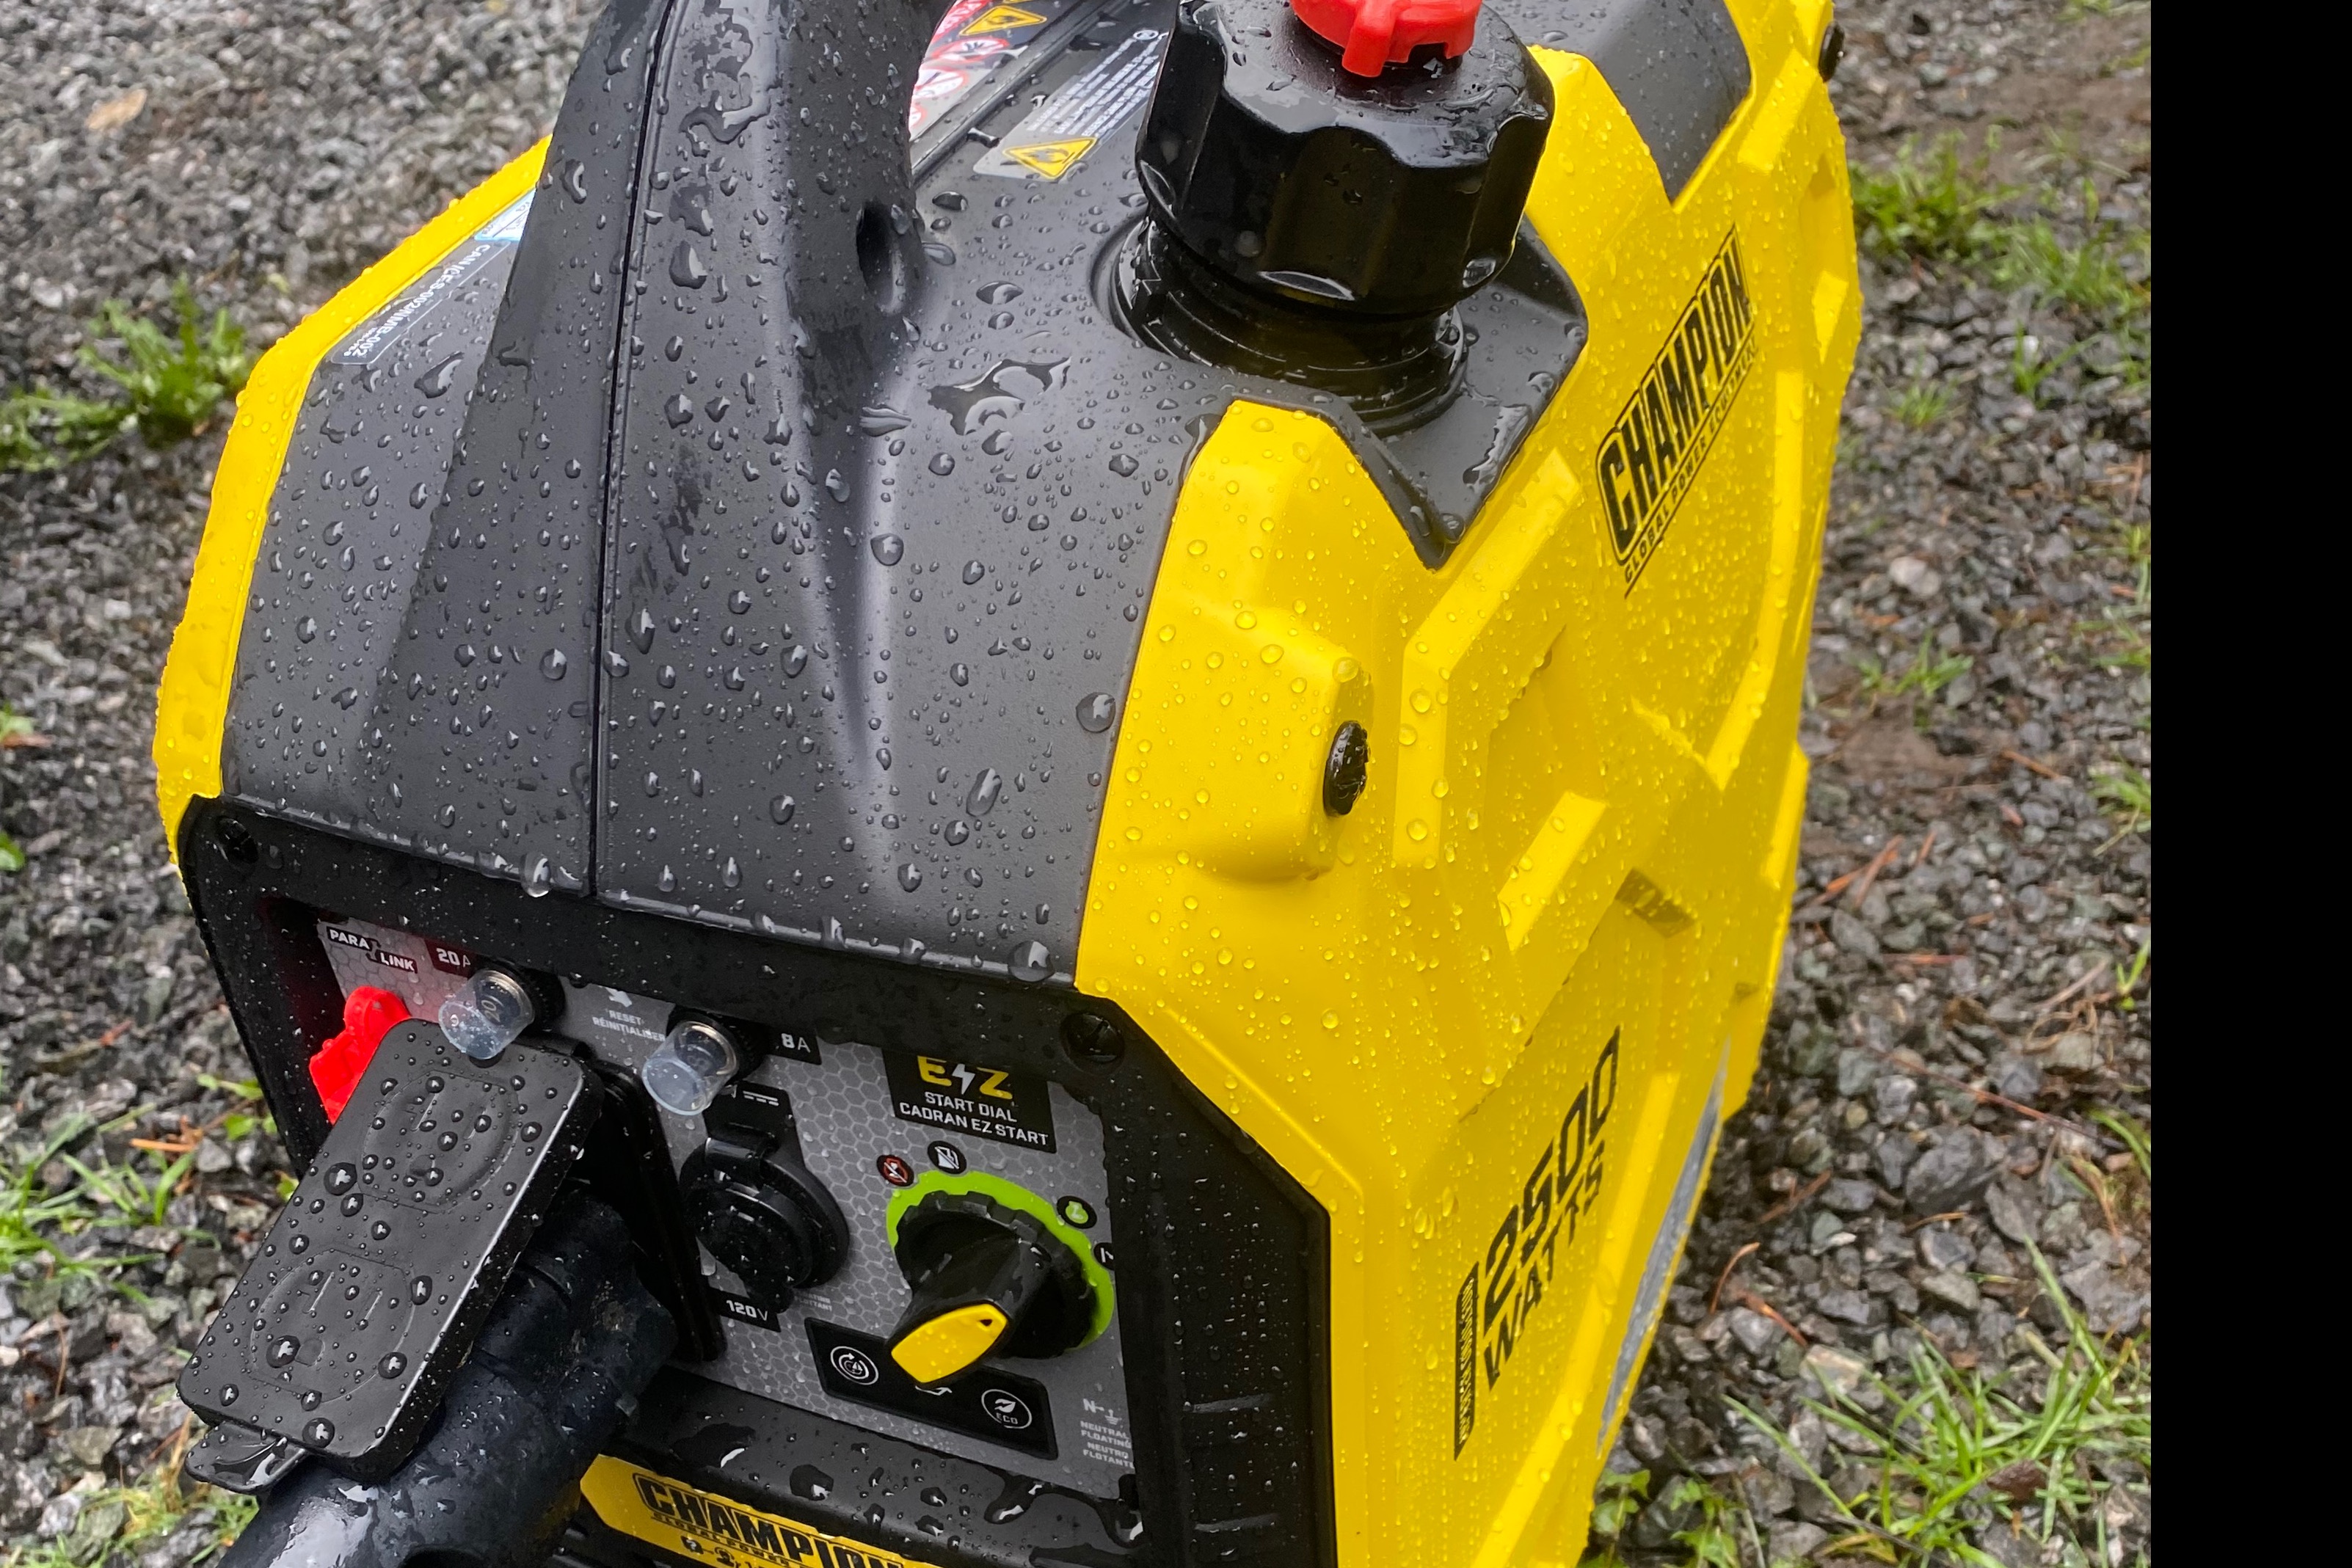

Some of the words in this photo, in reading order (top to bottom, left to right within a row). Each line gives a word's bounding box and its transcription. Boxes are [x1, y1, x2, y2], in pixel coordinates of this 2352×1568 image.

[457, 244, 491, 266] CAN
[1600, 236, 1752, 555] CHAMPION
[1624, 504, 1670, 583] GLOBAL
[1672, 435, 1706, 504] POWER
[330, 929, 371, 950] PARA
[380, 952, 415, 972] LINK
[608, 1010, 642, 1025] RESET
[924, 1091, 975, 1112] START
[978, 1103, 1018, 1123] DIAL
[900, 1102, 968, 1128] CADRAN
[971, 1118, 992, 1134] EZ
[995, 1123, 1049, 1145] START
[1483, 1025, 1620, 1338] 2500
[1483, 1139, 1605, 1392] WATTS
[996, 1412, 1018, 1424] ECO
[1080, 1421, 1130, 1440] NEUTRAL
[1081, 1429, 1132, 1448] FLOATING
[637, 1476, 900, 1568] CHAMPIO
